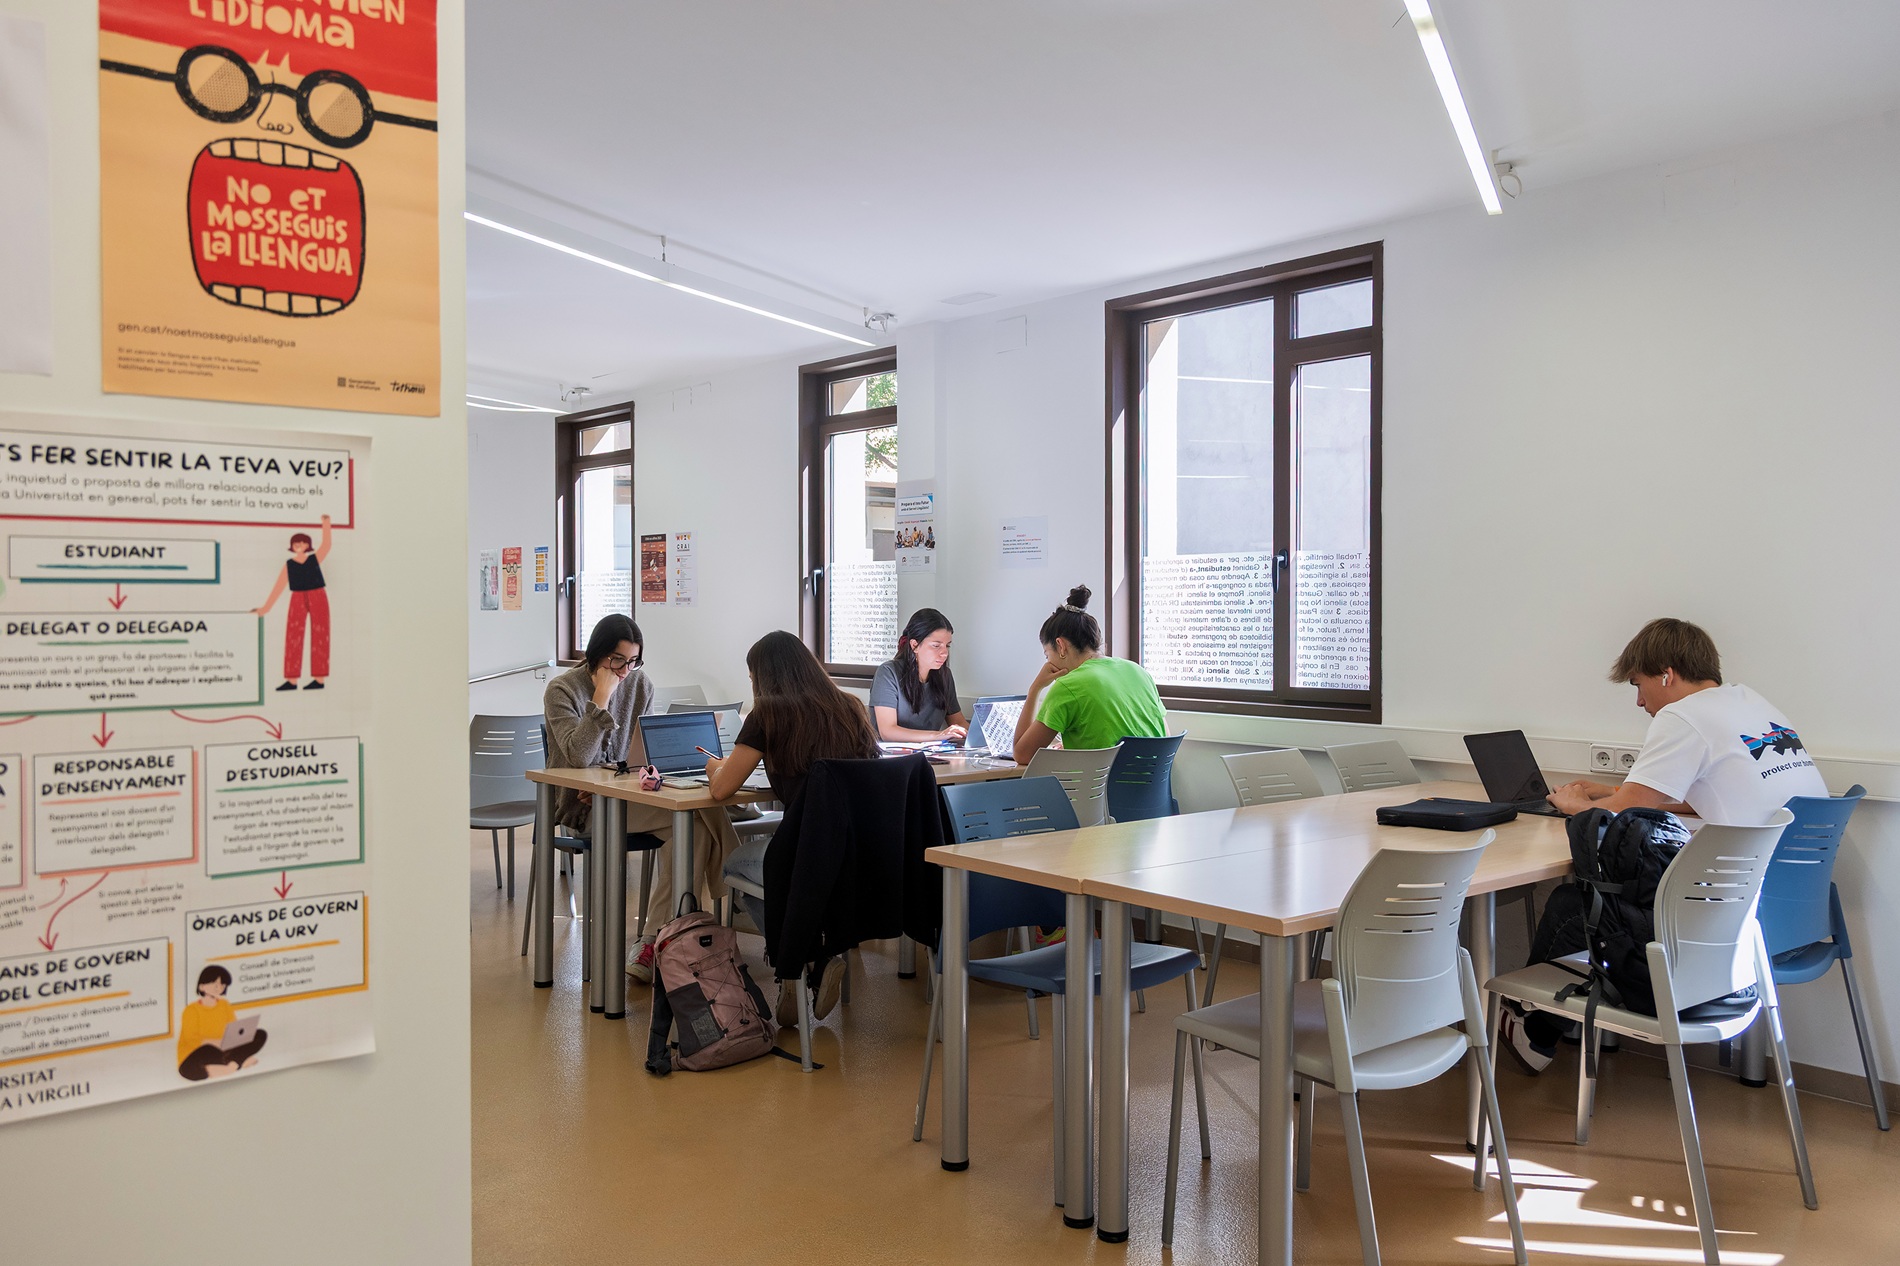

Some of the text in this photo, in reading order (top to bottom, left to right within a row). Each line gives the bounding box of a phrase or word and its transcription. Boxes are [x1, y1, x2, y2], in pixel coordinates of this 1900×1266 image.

[238, 231, 353, 276] LLENGUA
[31, 445, 76, 464] FER
[86, 448, 173, 469] SENTIR
[181, 453, 211, 471] LA
[219, 456, 281, 474] TEVA
[289, 460, 343, 480] VEU?
[6, 473, 324, 496] inquietud o proposta de millora relacionada amb els
[14, 490, 85, 502] Universitat
[88, 494, 104, 502] en
[162, 495, 187, 507] pots
[211, 496, 241, 508] sentir
[245, 497, 256, 508] la
[259, 498, 284, 510] teva
[64, 545, 166, 559] ESTUDIANT
[7, 620, 208, 636] DELEGAT O DELEGADA
[247, 744, 317, 761] CONSELL
[54, 755, 175, 774] RESPONSABLE
[226, 762, 338, 782] D'ESTUDIANTS
[1761, 762, 1792, 779] protect
[41, 774, 186, 796] D'ENSENYAMENT
[193, 899, 358, 931] ÒRGANS DE GOVERN
[235, 923, 319, 946] DE LA URV
[46, 958, 68, 974] DE
[74, 948, 150, 970] GOVERN
[38, 973, 112, 998] CENTRE
[27, 1081, 91, 1105] VIRGILI
